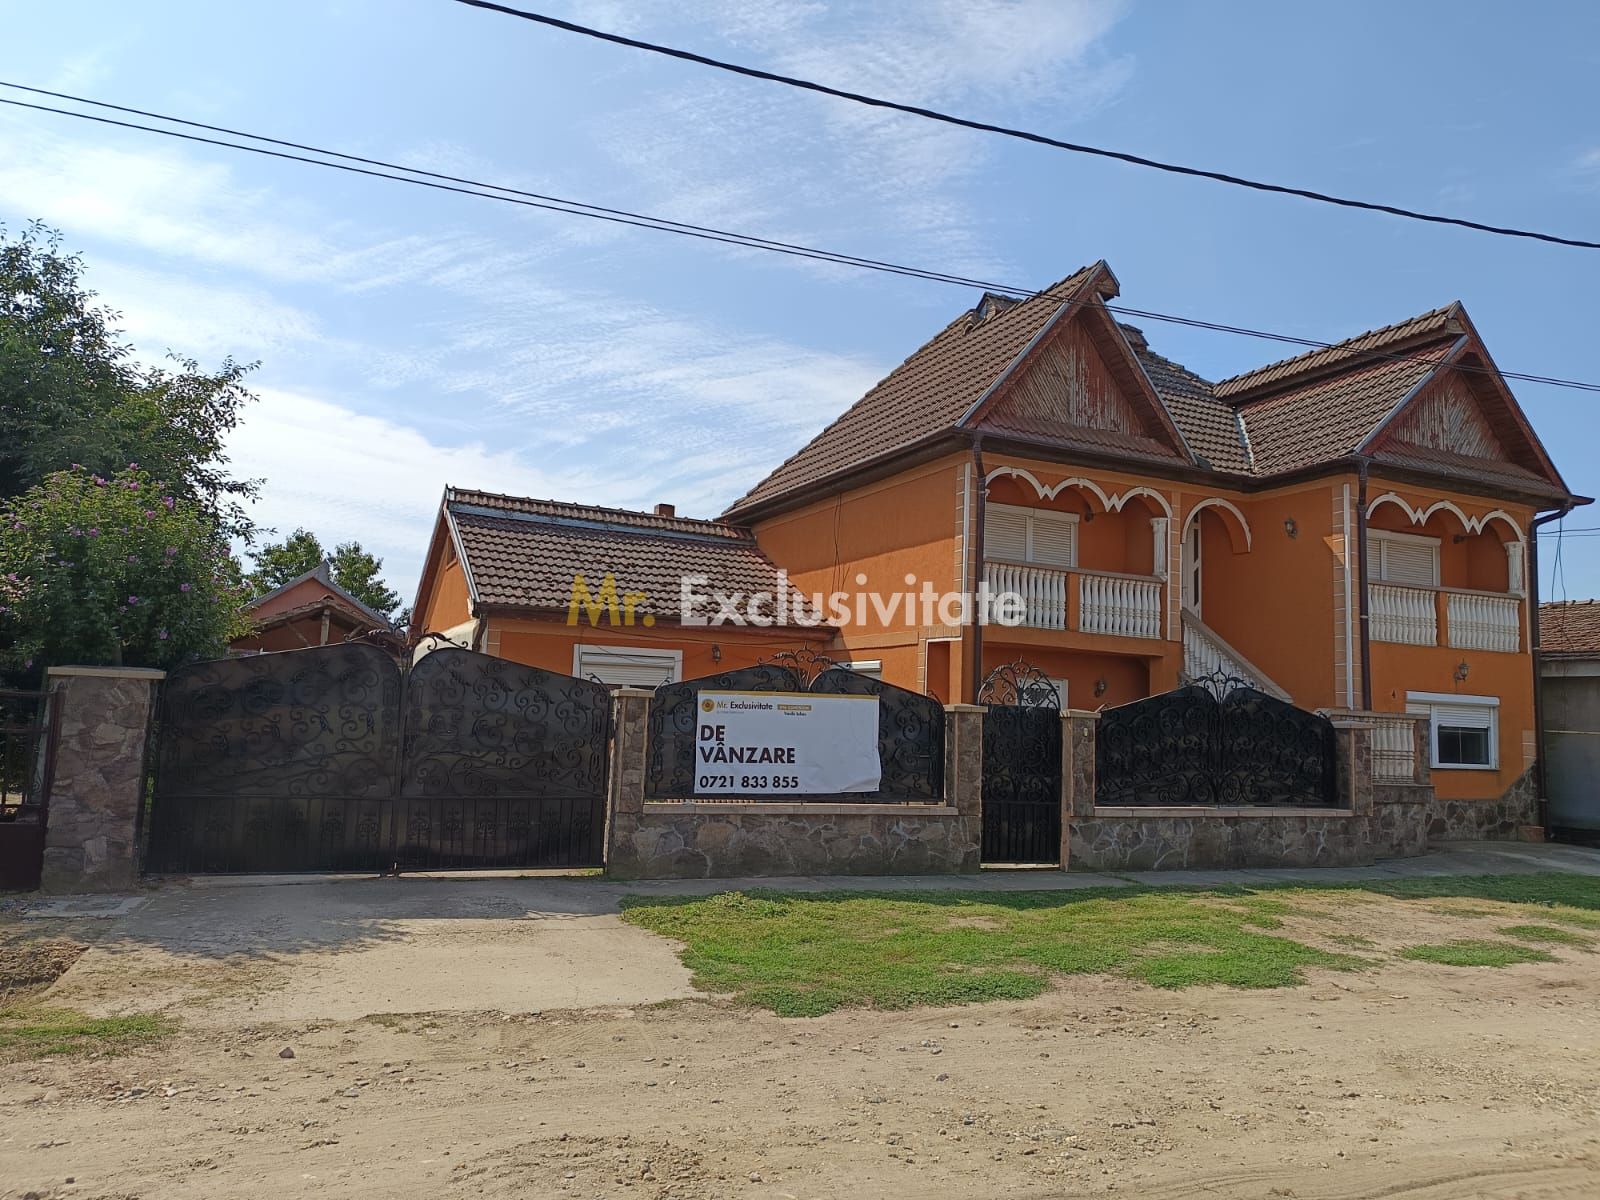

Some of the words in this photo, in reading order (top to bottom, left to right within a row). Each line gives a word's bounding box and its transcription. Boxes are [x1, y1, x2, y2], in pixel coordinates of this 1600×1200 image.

[716, 701, 728, 709] Mr.
[730, 701, 773, 710] Exclusivitate
[700, 725, 725, 742] DE
[699, 742, 796, 764] VÂNZARE
[700, 776, 734, 788] 0721
[741, 776, 767, 788] 833
[772, 776, 799, 788] 855
